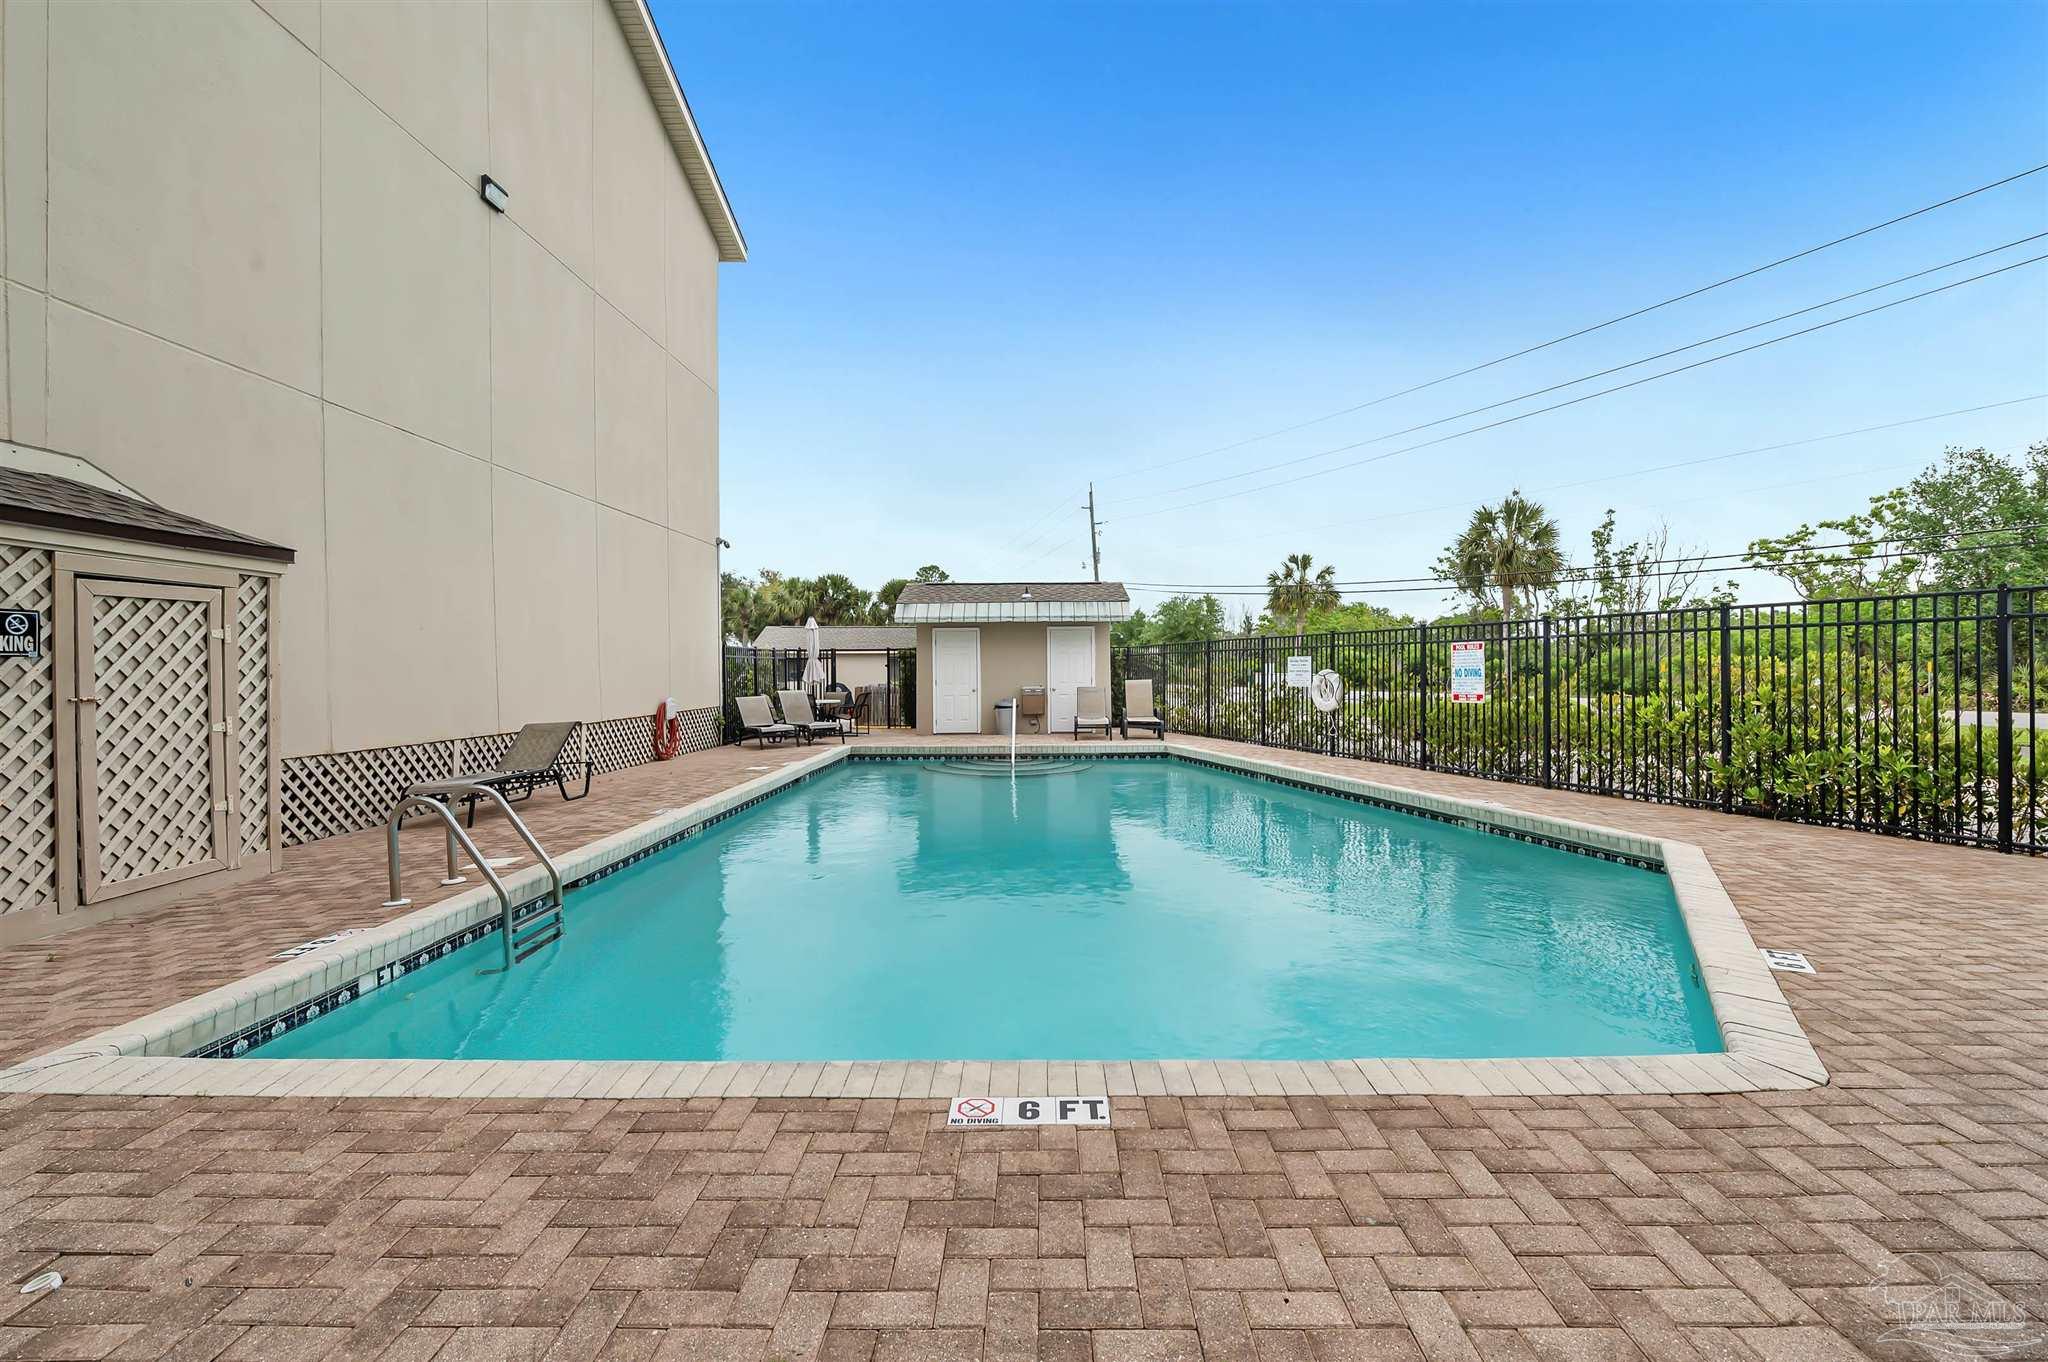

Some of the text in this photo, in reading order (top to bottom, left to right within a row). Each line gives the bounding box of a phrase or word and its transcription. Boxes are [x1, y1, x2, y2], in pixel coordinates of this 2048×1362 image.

[0, 635, 34, 652] KING
[1455, 667, 1482, 678] NO DIVING
[1018, 1101, 1040, 1120] 6
